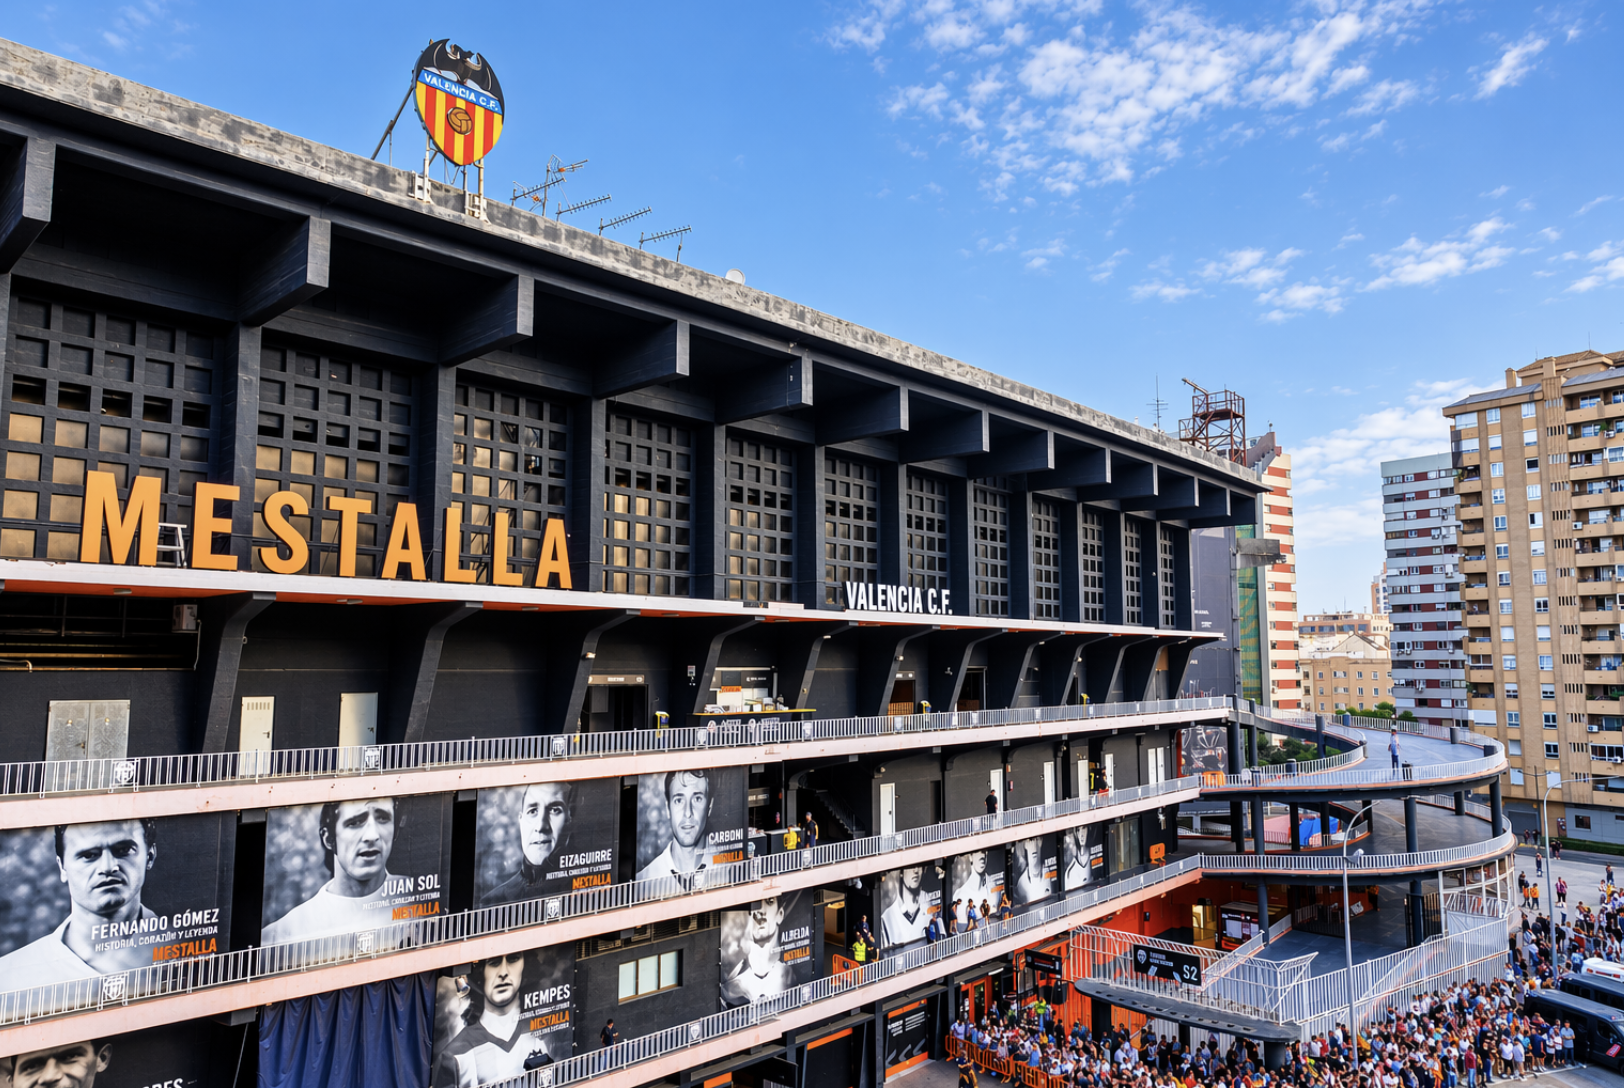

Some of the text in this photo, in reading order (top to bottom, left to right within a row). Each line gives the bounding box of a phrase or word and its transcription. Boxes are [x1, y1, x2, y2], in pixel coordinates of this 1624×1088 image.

[424, 72, 499, 112] VALENCIA C.F.
[80, 470, 573, 590] MESTALLA
[845, 581, 953, 615] VALENCIA C.F.
[708, 828, 743, 845] CARBONI
[560, 848, 613, 869] EIZAGUIRRE
[381, 874, 441, 897] JUAN SOL
[91, 908, 220, 940] FERNANDO GÓMEZ
[152, 937, 218, 962] MESTALLA
[1183, 964, 1198, 981] S2
[523, 983, 571, 1009] KEMPES
